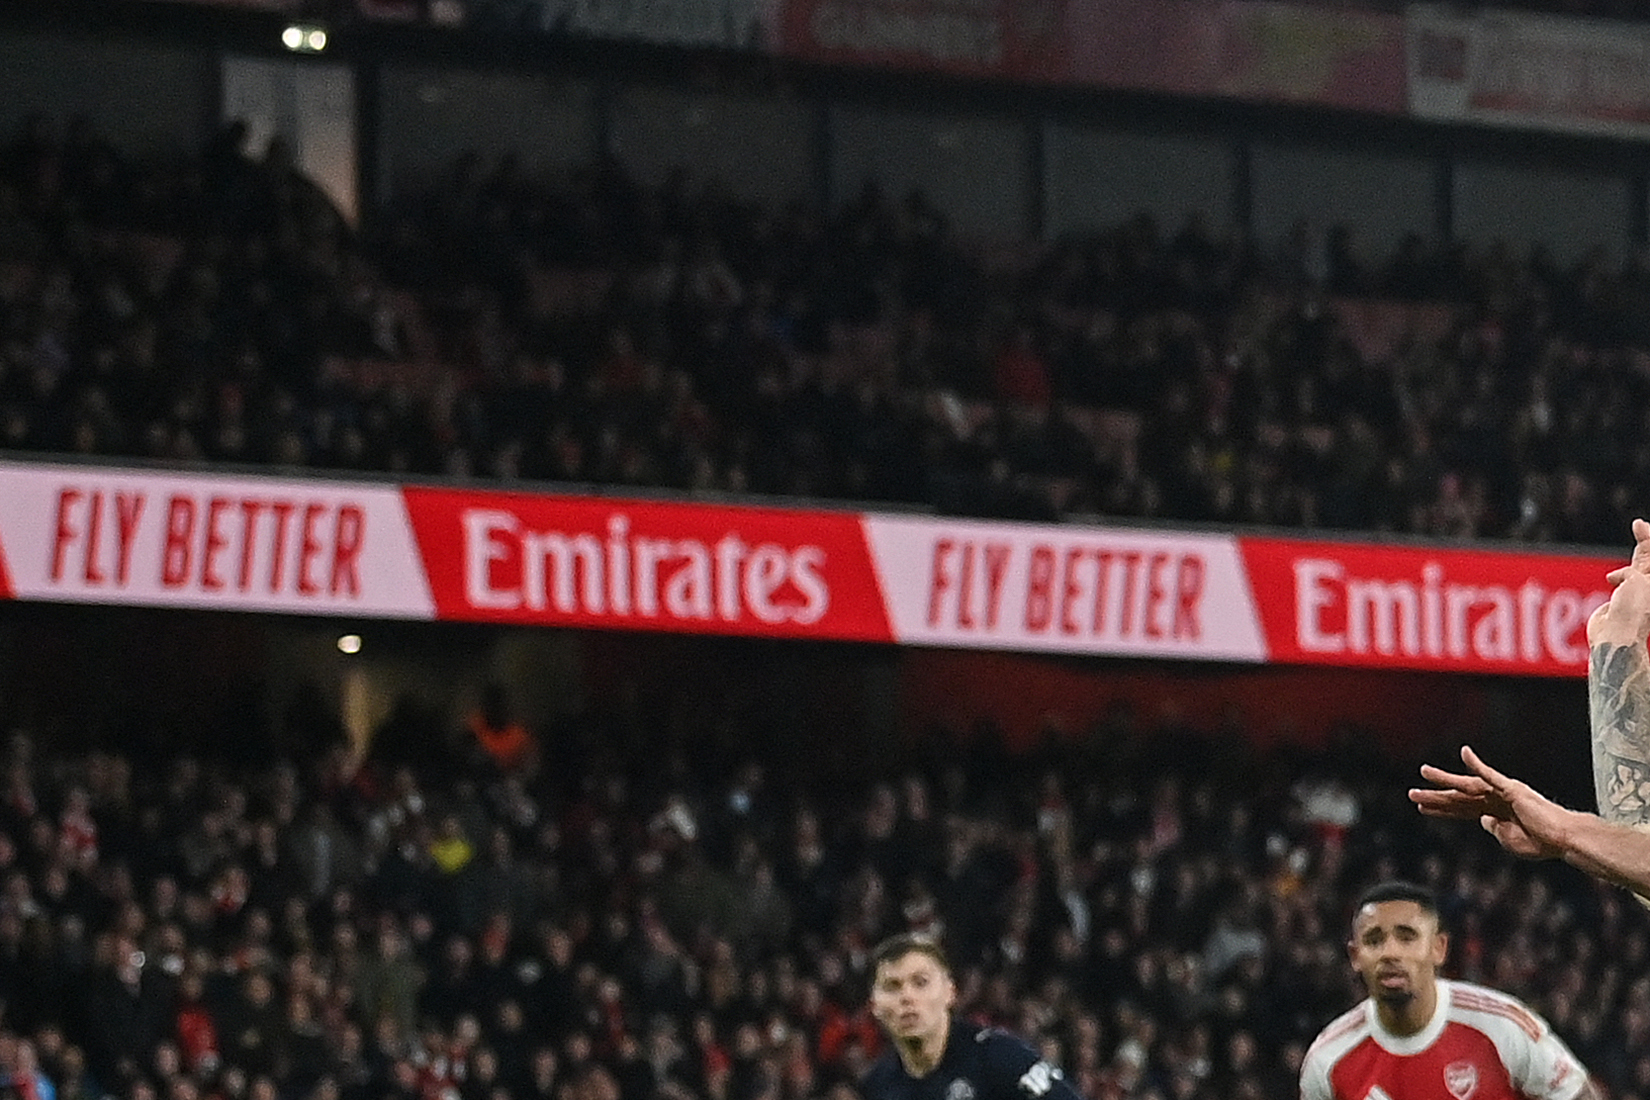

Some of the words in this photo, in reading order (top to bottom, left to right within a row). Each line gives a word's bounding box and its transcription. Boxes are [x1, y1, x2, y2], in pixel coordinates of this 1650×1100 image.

[49, 486, 147, 588] FLY
[160, 495, 367, 599] BETTER
[461, 509, 831, 625] Emirates
[925, 536, 1012, 632] FLY
[1019, 543, 1208, 641] BETTER
[1292, 557, 1610, 664] Emirate
